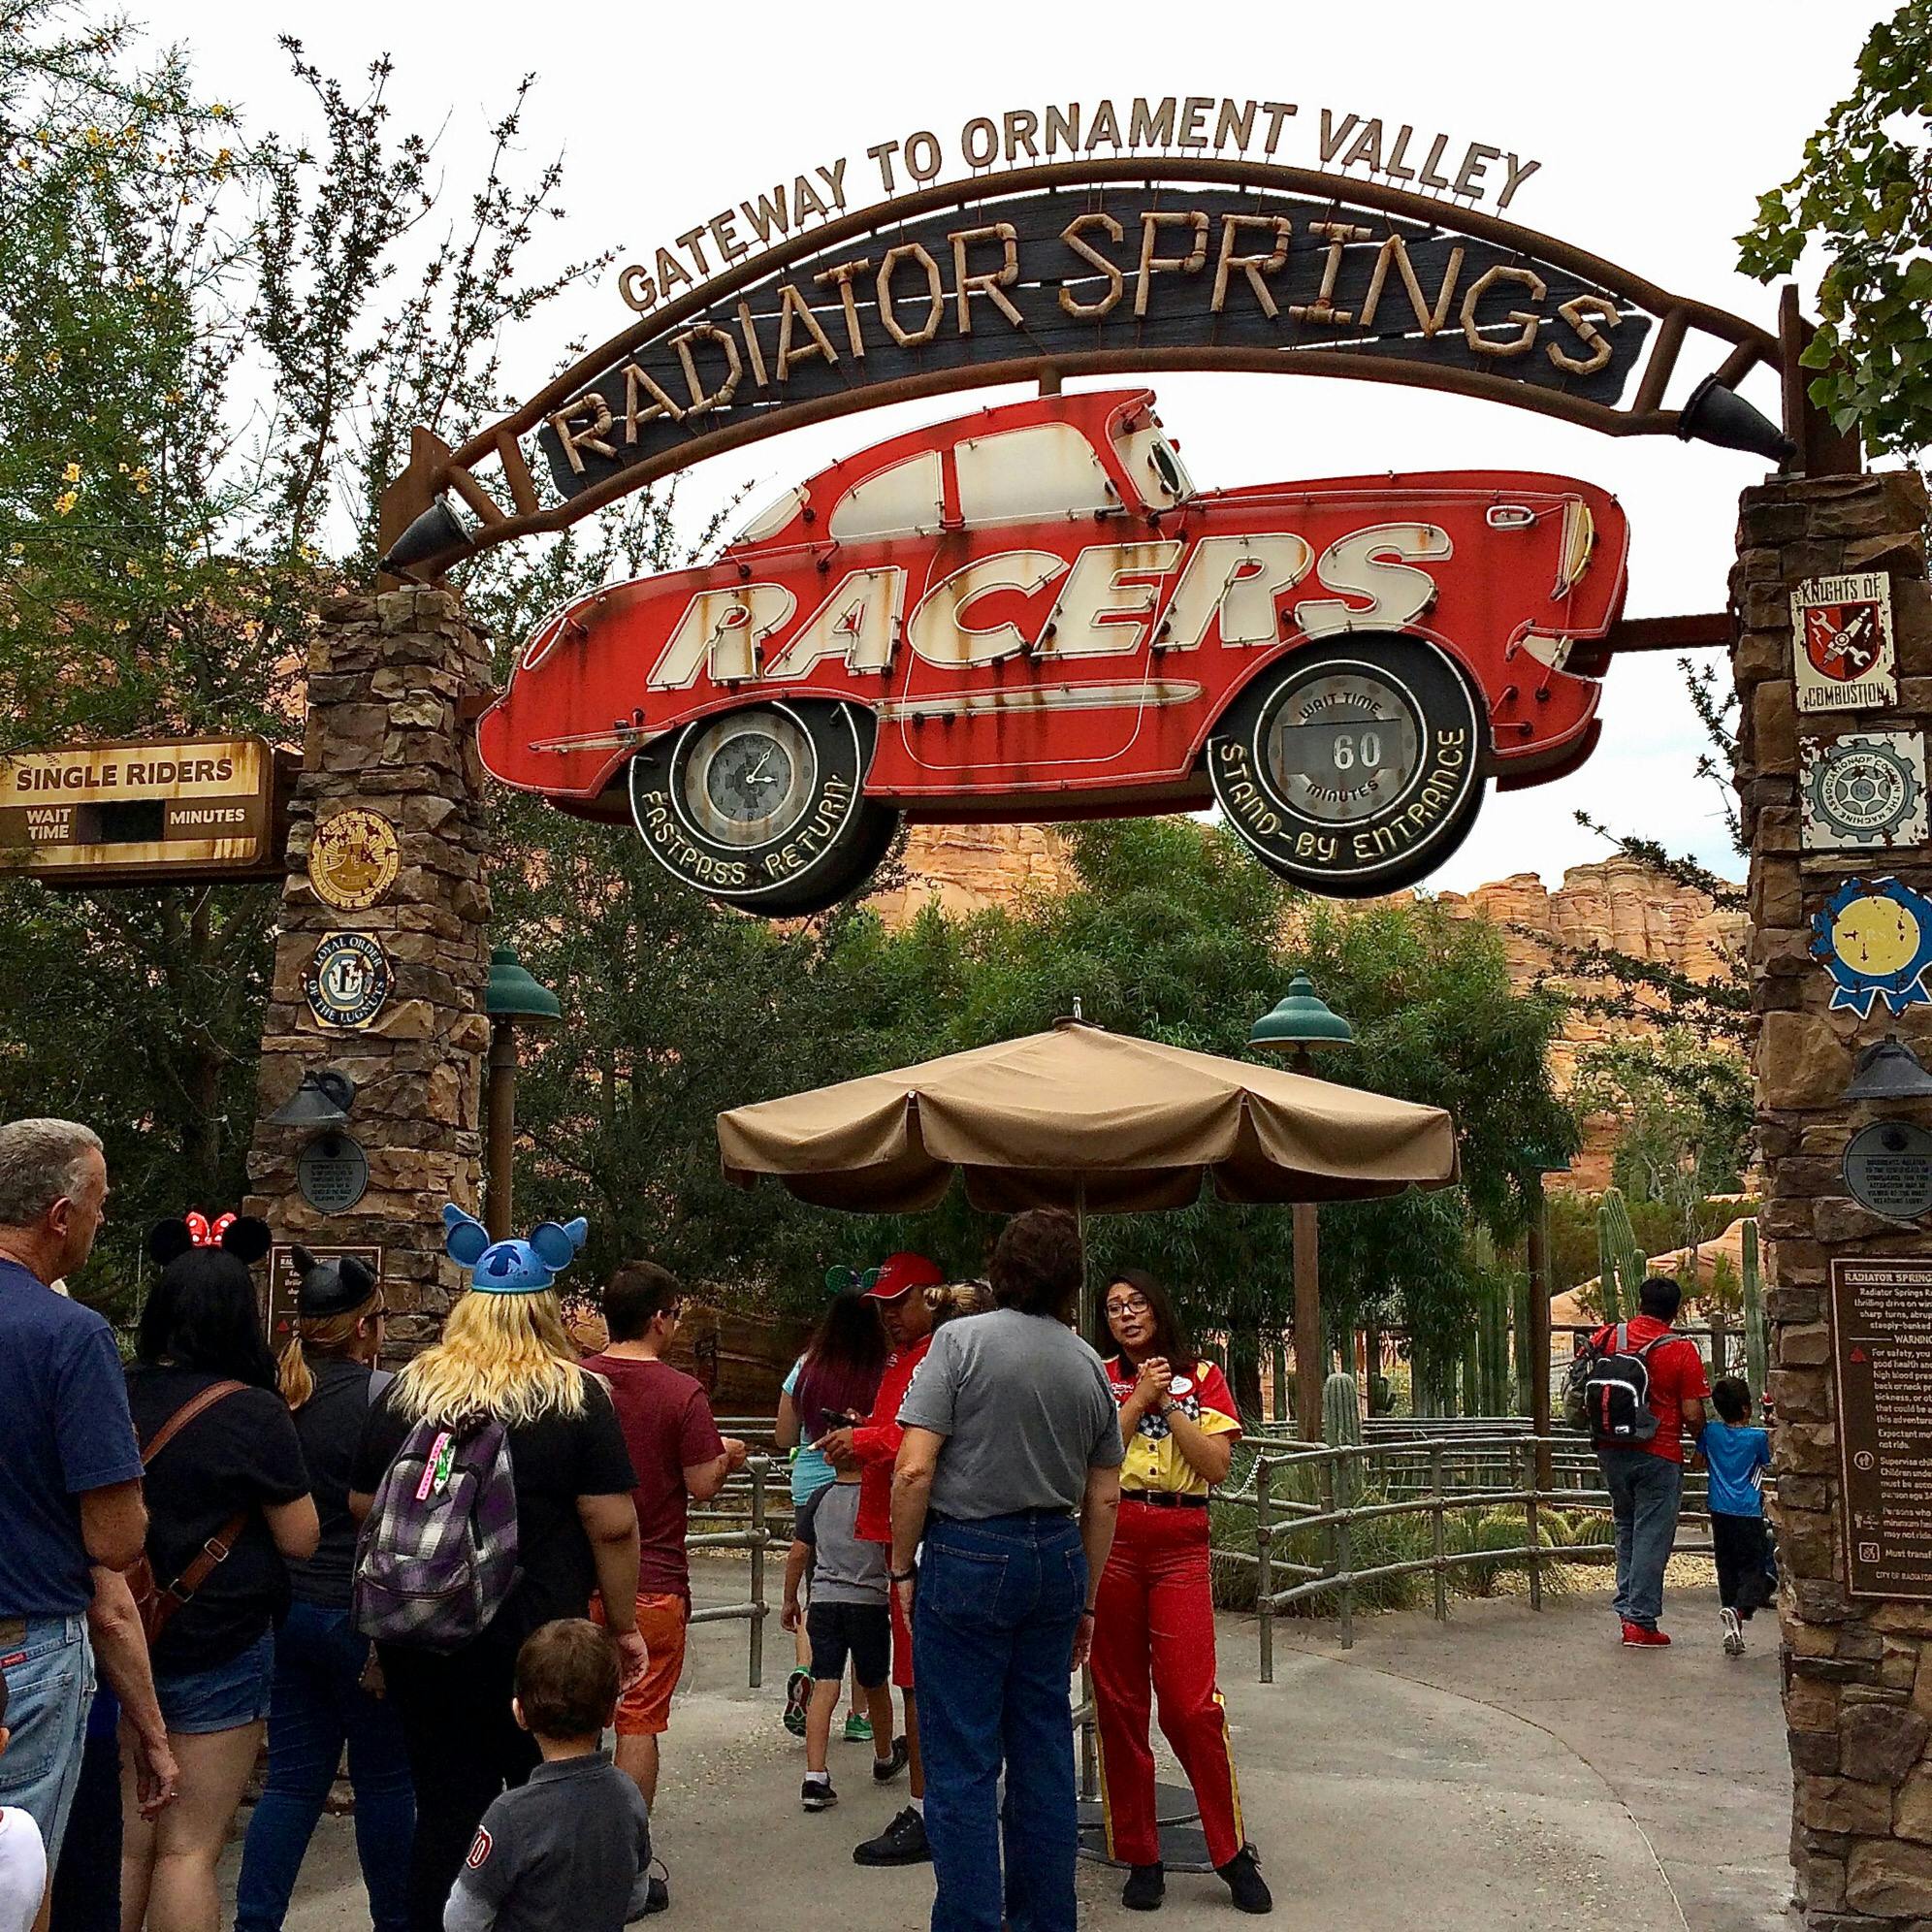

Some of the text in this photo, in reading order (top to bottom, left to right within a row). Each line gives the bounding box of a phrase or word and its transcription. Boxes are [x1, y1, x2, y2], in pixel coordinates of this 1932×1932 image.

[619, 97, 1541, 312] GATEWAY TO ORNAMENT VALLEY
[546, 209, 1623, 474] RADIATOR SPRINGS
[1800, 577, 1882, 602] KNIGHTS OF
[645, 522, 1453, 691] RACERS
[1300, 692, 1382, 720] WAIT TIME
[1808, 682, 1884, 707] COMBUSTION
[1333, 731, 1381, 770] 60
[16, 759, 233, 791] SINGLE RIDERS
[1825, 757, 1857, 812] ASSOCIATION
[1305, 780, 1379, 802] MINUTES
[1353, 727, 1465, 859] ENTRANCE
[1885, 795, 1901, 813] THE
[26, 808, 72, 824] WAIT
[170, 808, 245, 824] MINUTES
[642, 773, 853, 885] FASTPASS RETURN
[1839, 811, 1886, 824] MACHINE
[28, 824, 70, 840] TIME
[313, 937, 383, 968] LOYAL ORDER
[308, 980, 385, 1022] OF THE LUGNUTS
[1845, 1273, 1893, 1282] RADIATOR
[1860, 1288, 1892, 1297] Radiator
[1894, 1288, 1923, 1298] Springs
[1872, 1348, 1885, 1357] For
